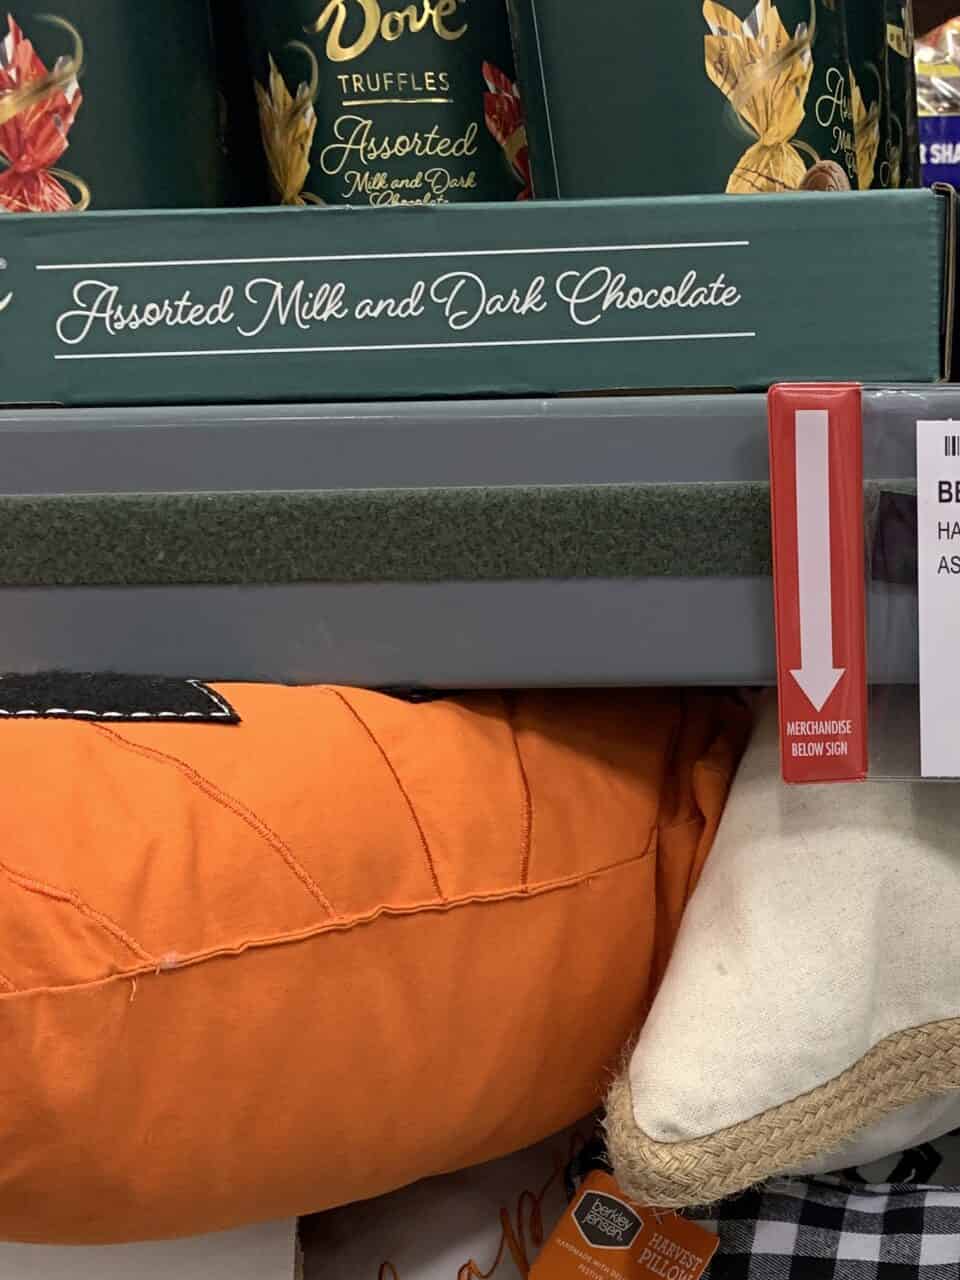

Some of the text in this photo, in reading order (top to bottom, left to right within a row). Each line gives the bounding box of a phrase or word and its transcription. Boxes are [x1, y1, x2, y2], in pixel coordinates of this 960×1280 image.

[303, 0, 468, 61] Dove
[337, 72, 450, 93] TRUFFLES
[321, 115, 478, 174] Assorted
[342, 168, 477, 198] Milk and Dark
[56, 265, 743, 344] Assorted Milk and Dark Chocolate
[786, 720, 852, 736] MERCHANDISE
[792, 741, 848, 757] BELOW SIGN
[648, 1232, 703, 1272] HARVEST
